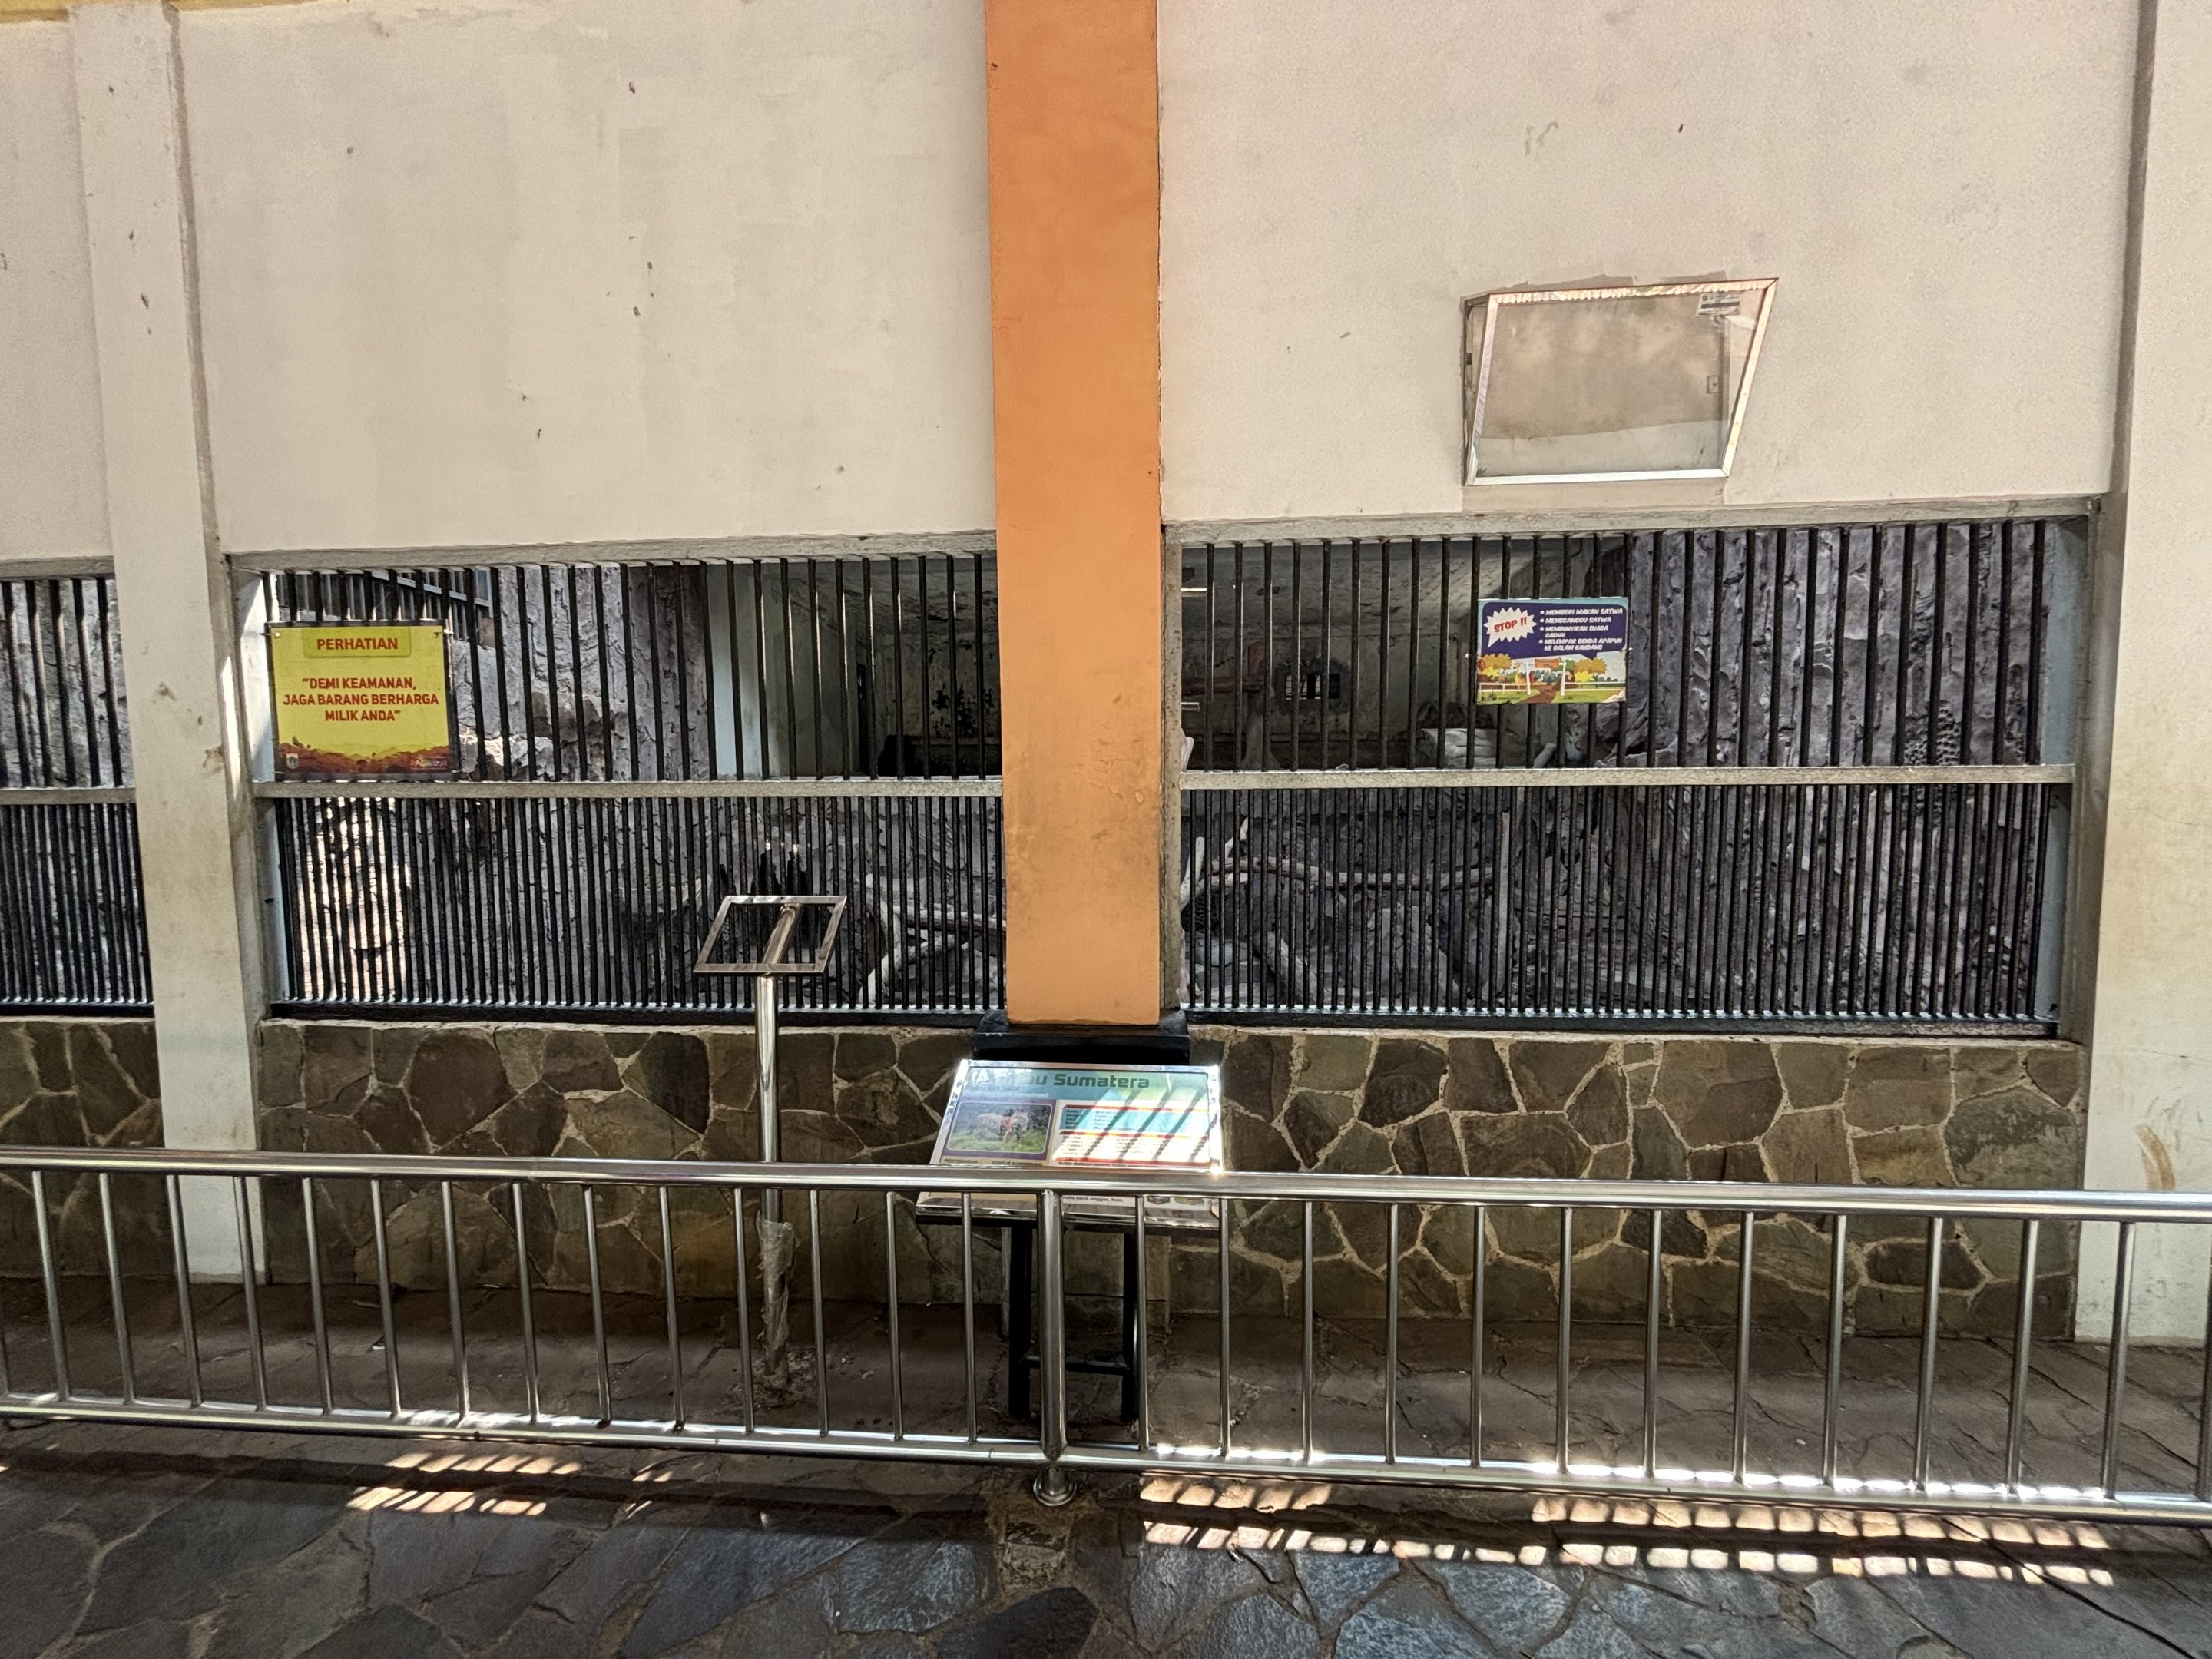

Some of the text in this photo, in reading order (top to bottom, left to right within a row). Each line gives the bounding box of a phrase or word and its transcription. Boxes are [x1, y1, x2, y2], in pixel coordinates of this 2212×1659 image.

[1494, 620, 1517, 632] STOP
[316, 637, 399, 650] PERHATIAN
[343, 677, 416, 690] KEAMANAN,
[283, 694, 439, 705] JAGA BARANG BERHARGA
[325, 710, 359, 721] MILIK
[1053, 1073, 1150, 1088] Sumatera
